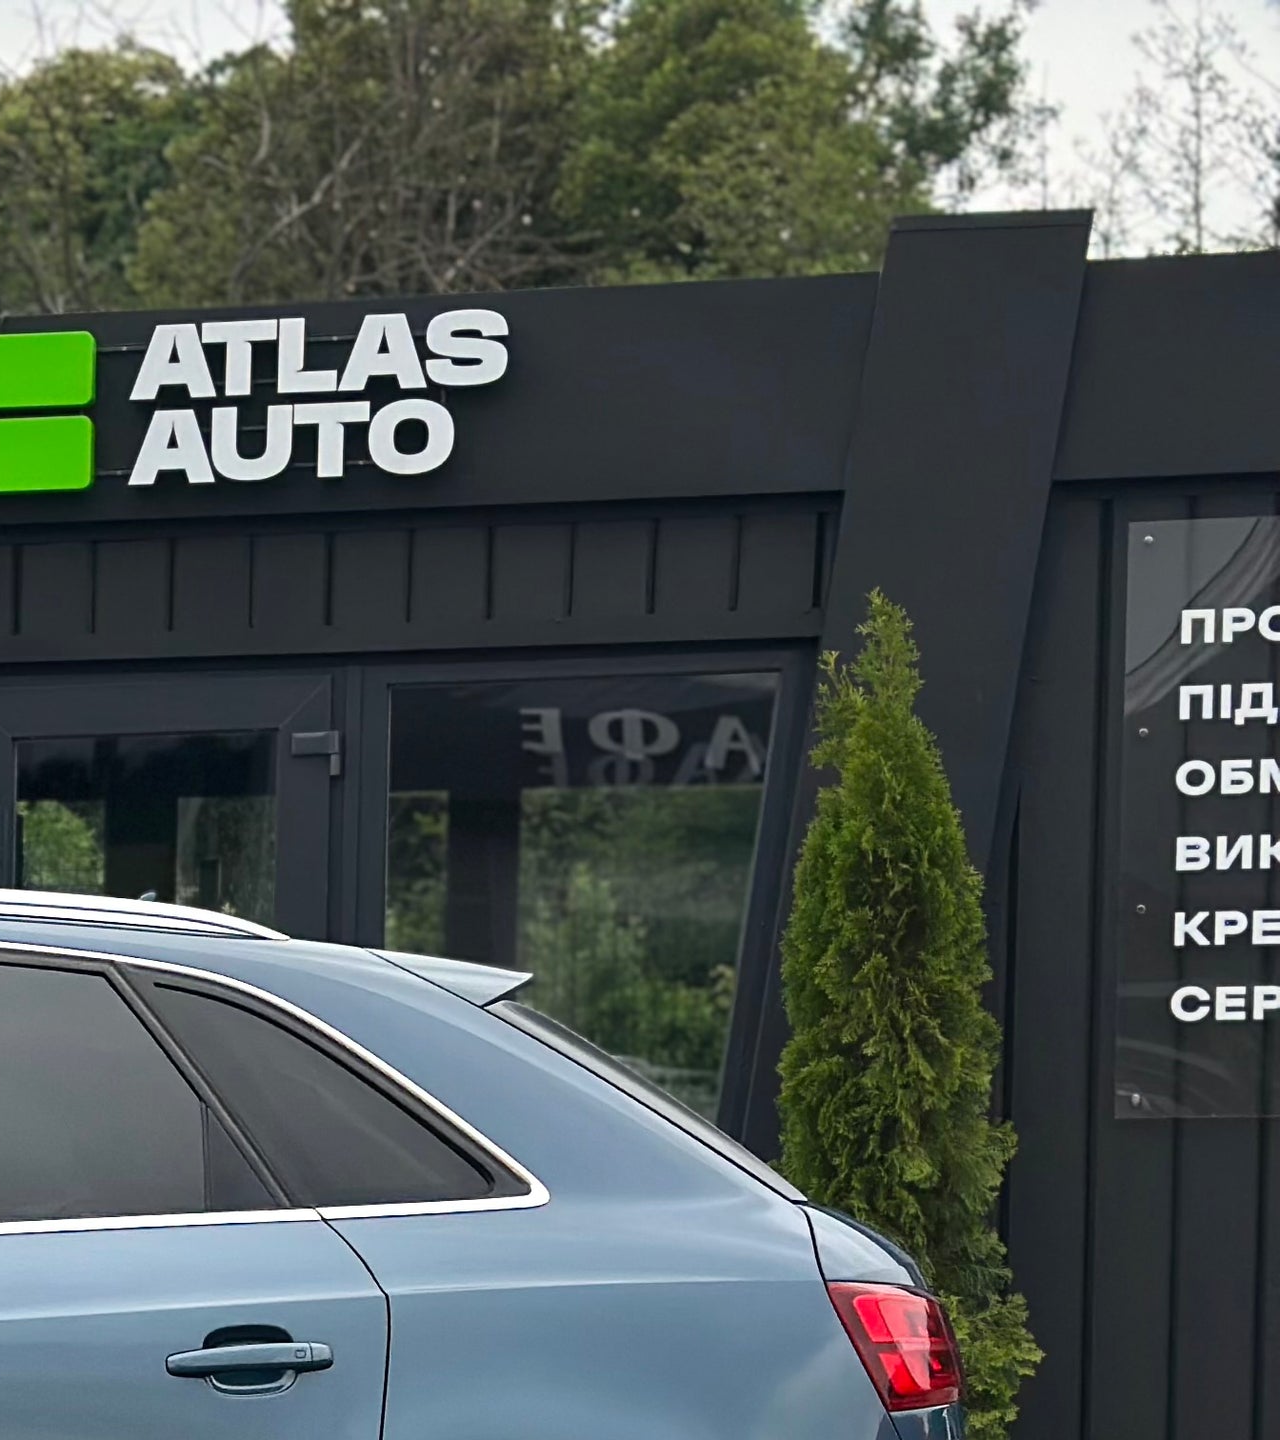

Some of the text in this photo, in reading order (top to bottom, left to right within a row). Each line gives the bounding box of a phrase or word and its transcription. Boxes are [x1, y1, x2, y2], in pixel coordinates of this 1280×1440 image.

[129, 308, 509, 400] ATLAS
[128, 398, 455, 487] AUTO
[1178, 682, 1279, 726] ПІД
[1173, 910, 1280, 947] КРЕ
[1170, 985, 1280, 1022] СЕР
